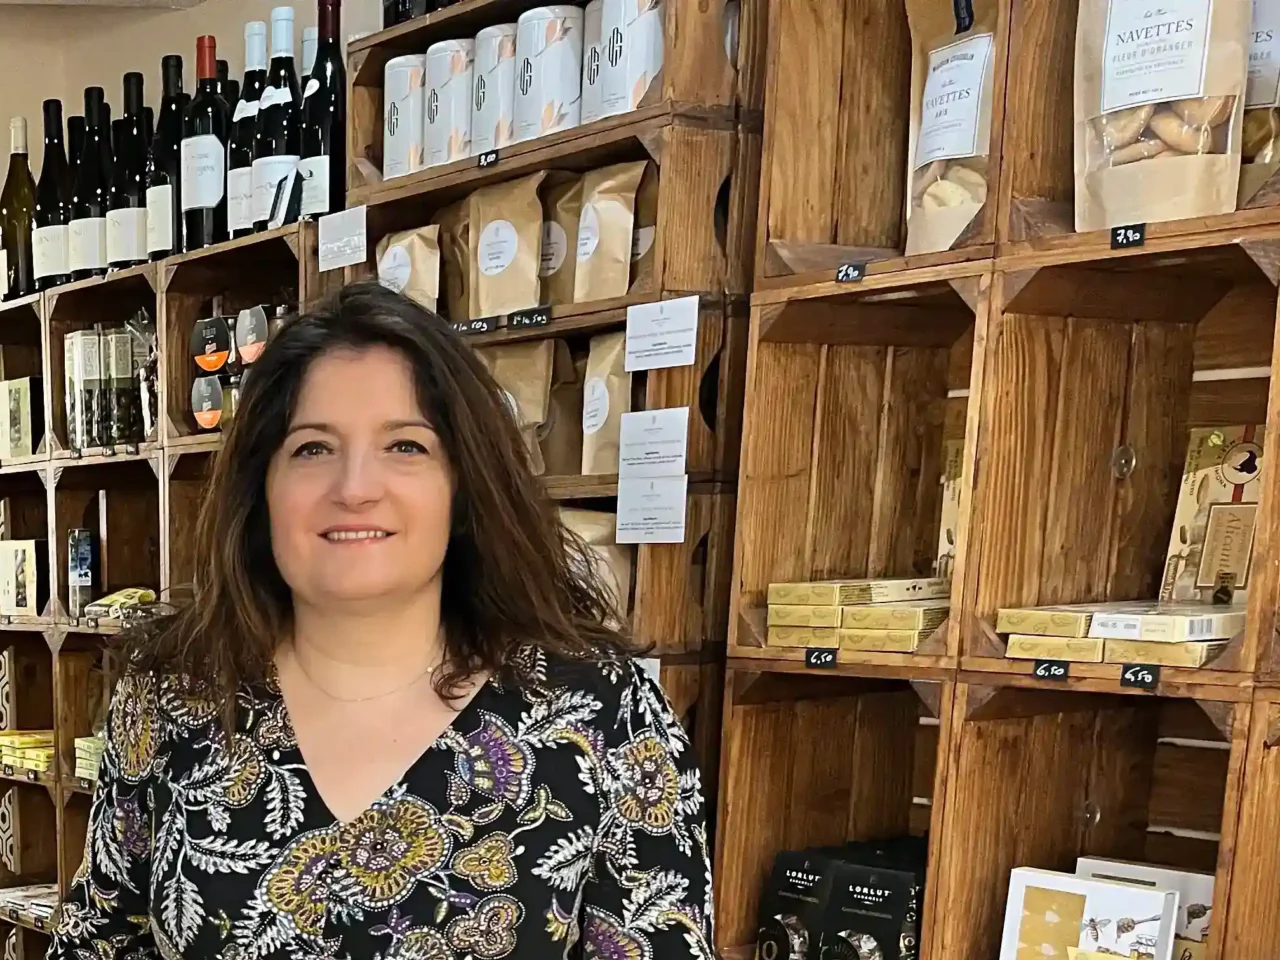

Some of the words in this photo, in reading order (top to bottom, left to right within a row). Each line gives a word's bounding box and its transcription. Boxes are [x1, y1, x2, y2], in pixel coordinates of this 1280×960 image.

[1116, 18, 1195, 46] NAVETTES
[1112, 51, 1138, 63] FLEUR
[925, 87, 972, 110] NAVETTES
[786, 869, 821, 883] LORLUT
[848, 884, 891, 898] LORLUT
